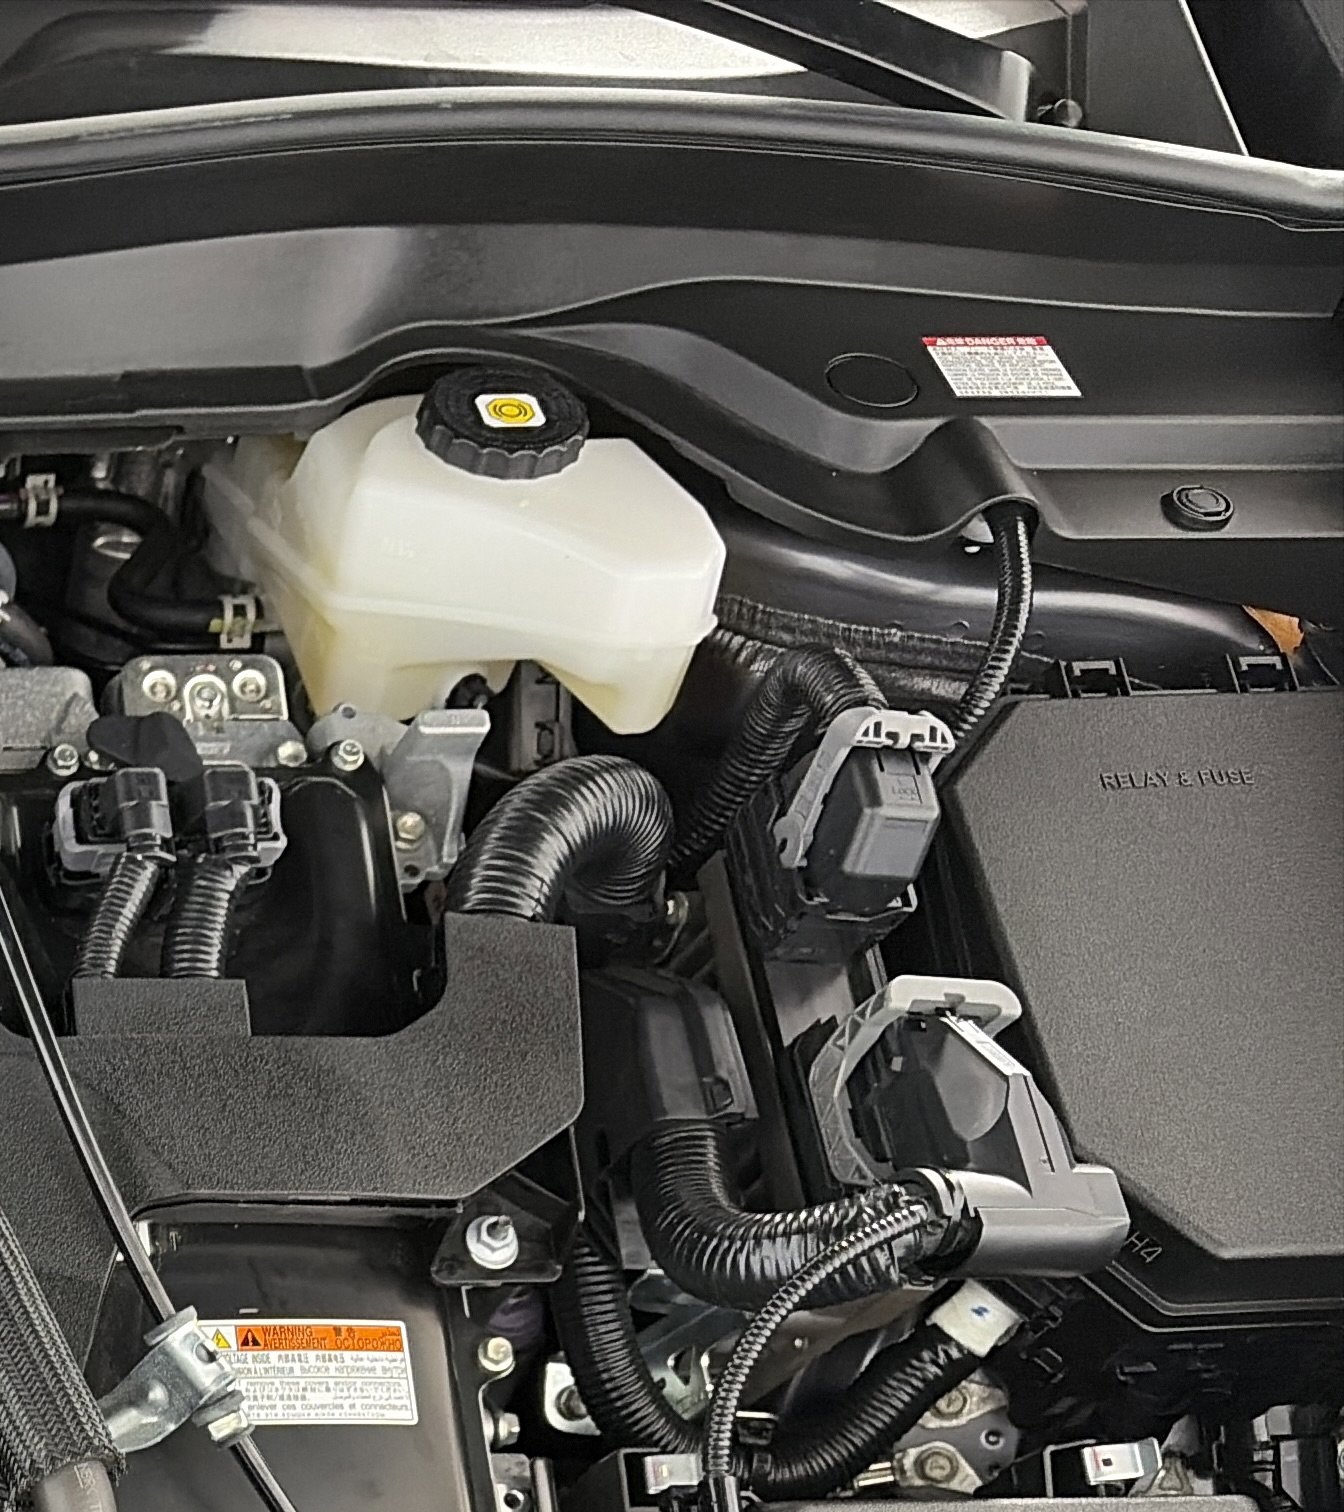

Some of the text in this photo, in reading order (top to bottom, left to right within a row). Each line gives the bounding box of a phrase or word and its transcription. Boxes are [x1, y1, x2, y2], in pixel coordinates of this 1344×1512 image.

[965, 336, 1016, 346] DANGER
[1100, 769, 1255, 790] RELAY & FUSE
[262, 1326, 313, 1338] WARNING
[263, 1338, 327, 1350] AVERTISSEMENT
